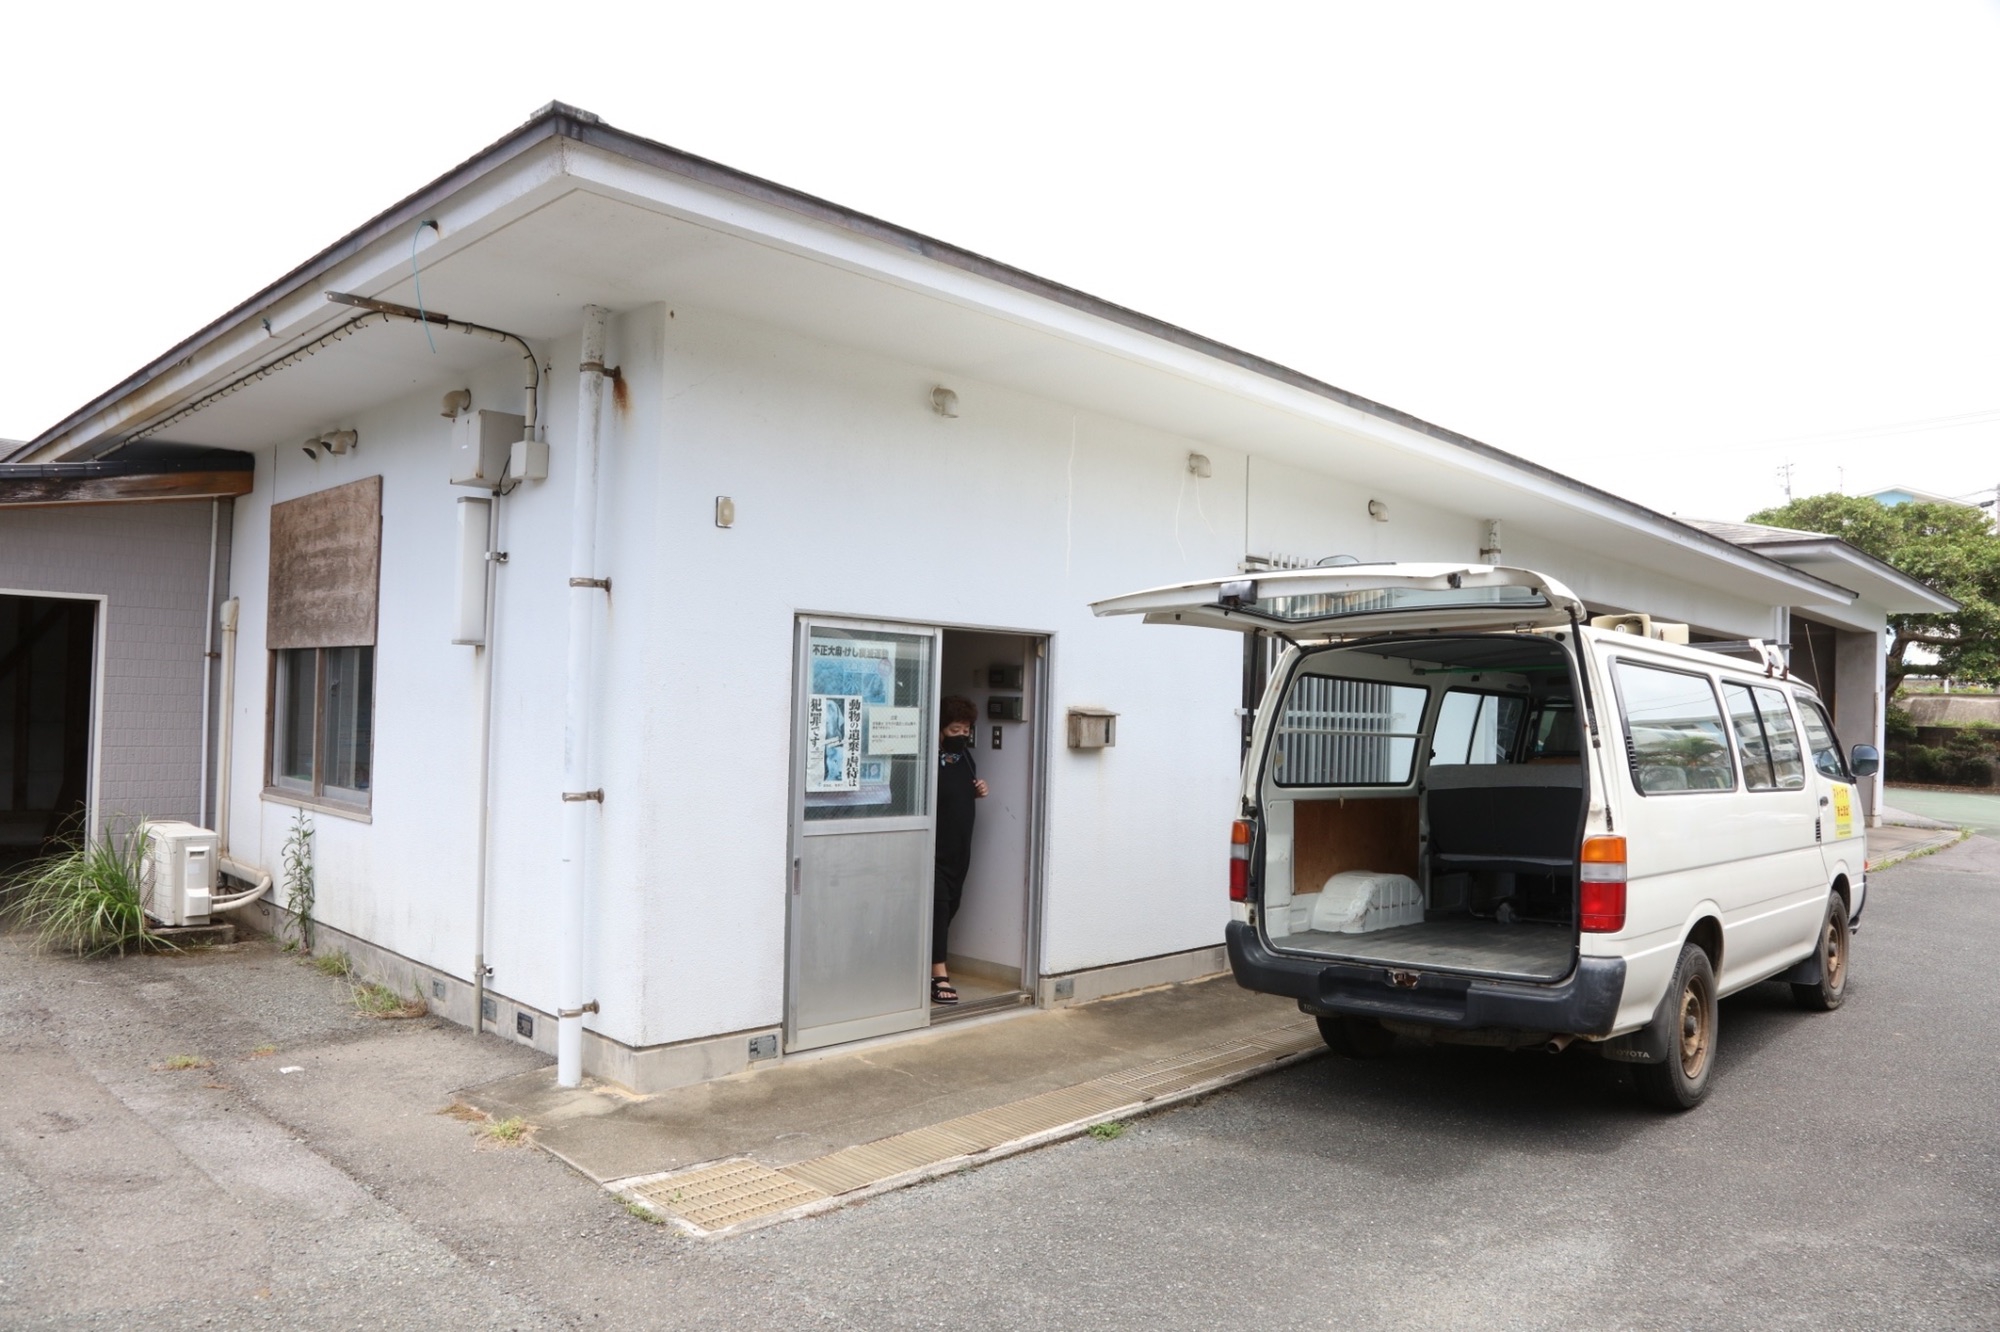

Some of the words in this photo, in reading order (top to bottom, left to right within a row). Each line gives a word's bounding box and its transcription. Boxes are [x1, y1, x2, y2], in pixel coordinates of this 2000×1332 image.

[846, 698, 861, 787] 動物の遺棄・虐待は
[1613, 1049, 1650, 1059] OYOTA
